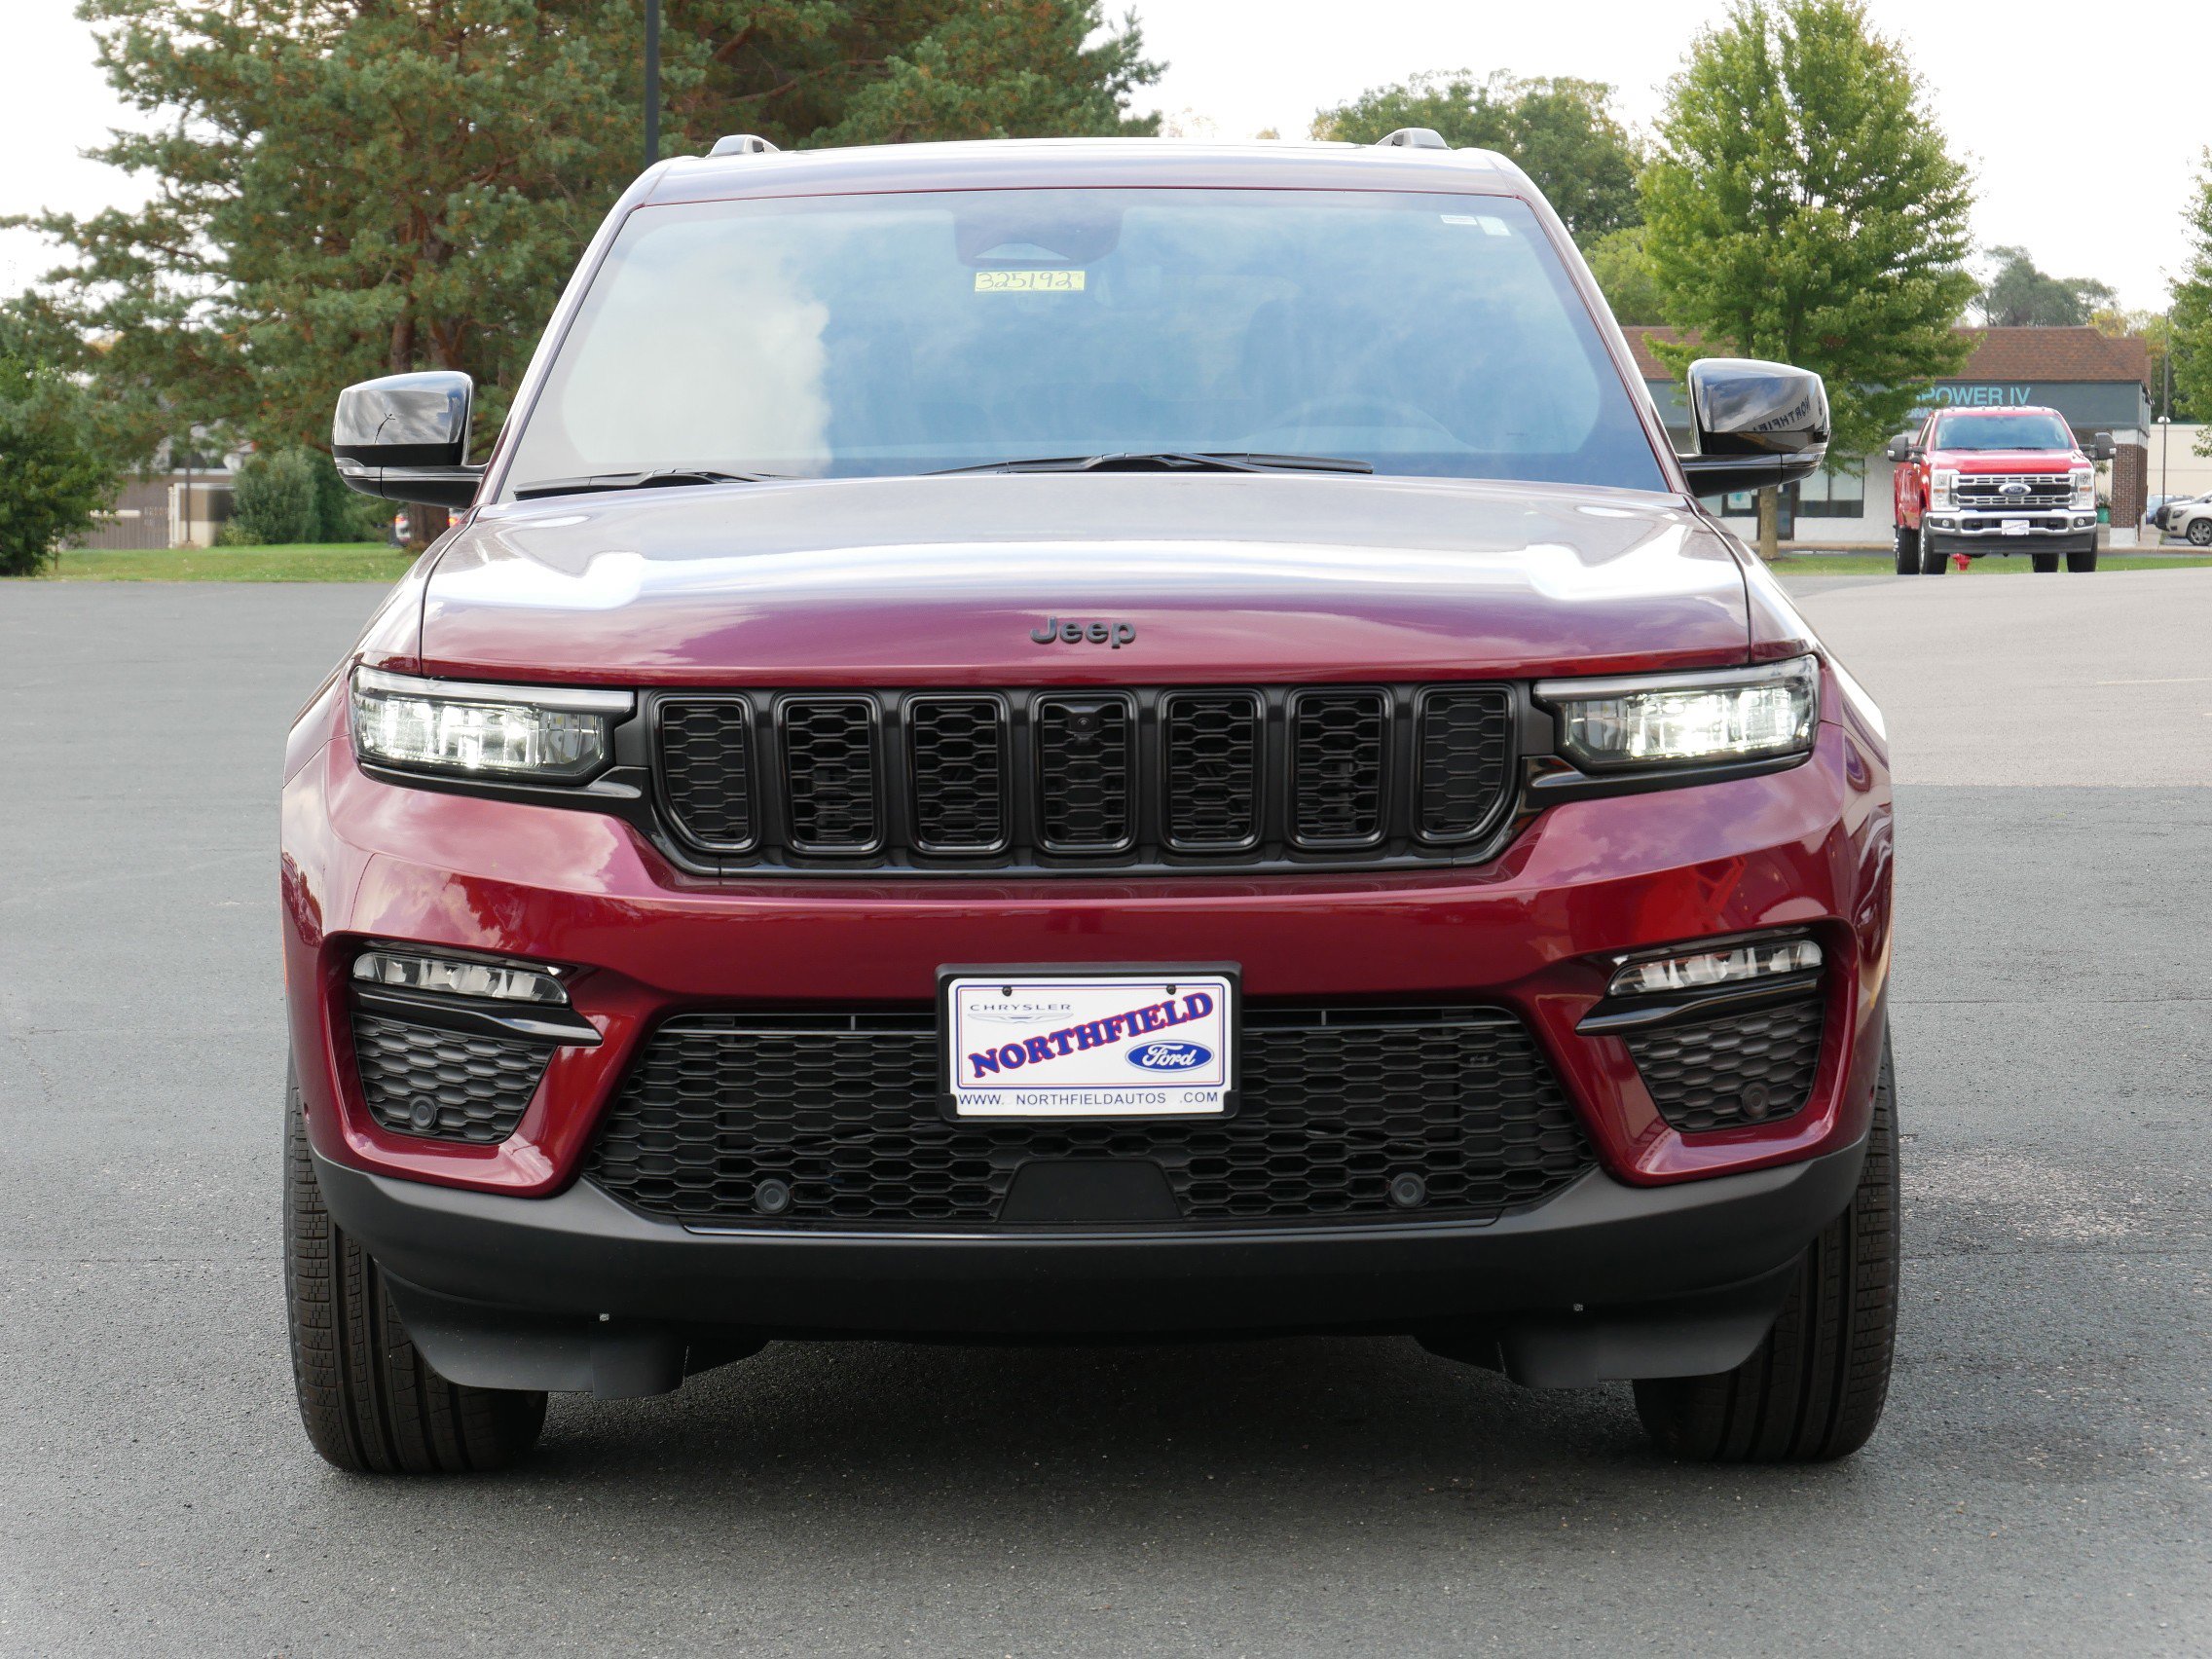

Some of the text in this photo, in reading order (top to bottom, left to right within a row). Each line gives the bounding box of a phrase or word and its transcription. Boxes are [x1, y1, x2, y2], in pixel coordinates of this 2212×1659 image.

[976, 272, 1072, 290] 325192
[1916, 387, 2031, 405] POWER IV
[1030, 616, 1136, 649] Jeep
[968, 992, 1214, 1079] NORTHFIELD
[1141, 1043, 1198, 1068] Ford
[1016, 1092, 1166, 1106] NORTHFIELDAUTOS
